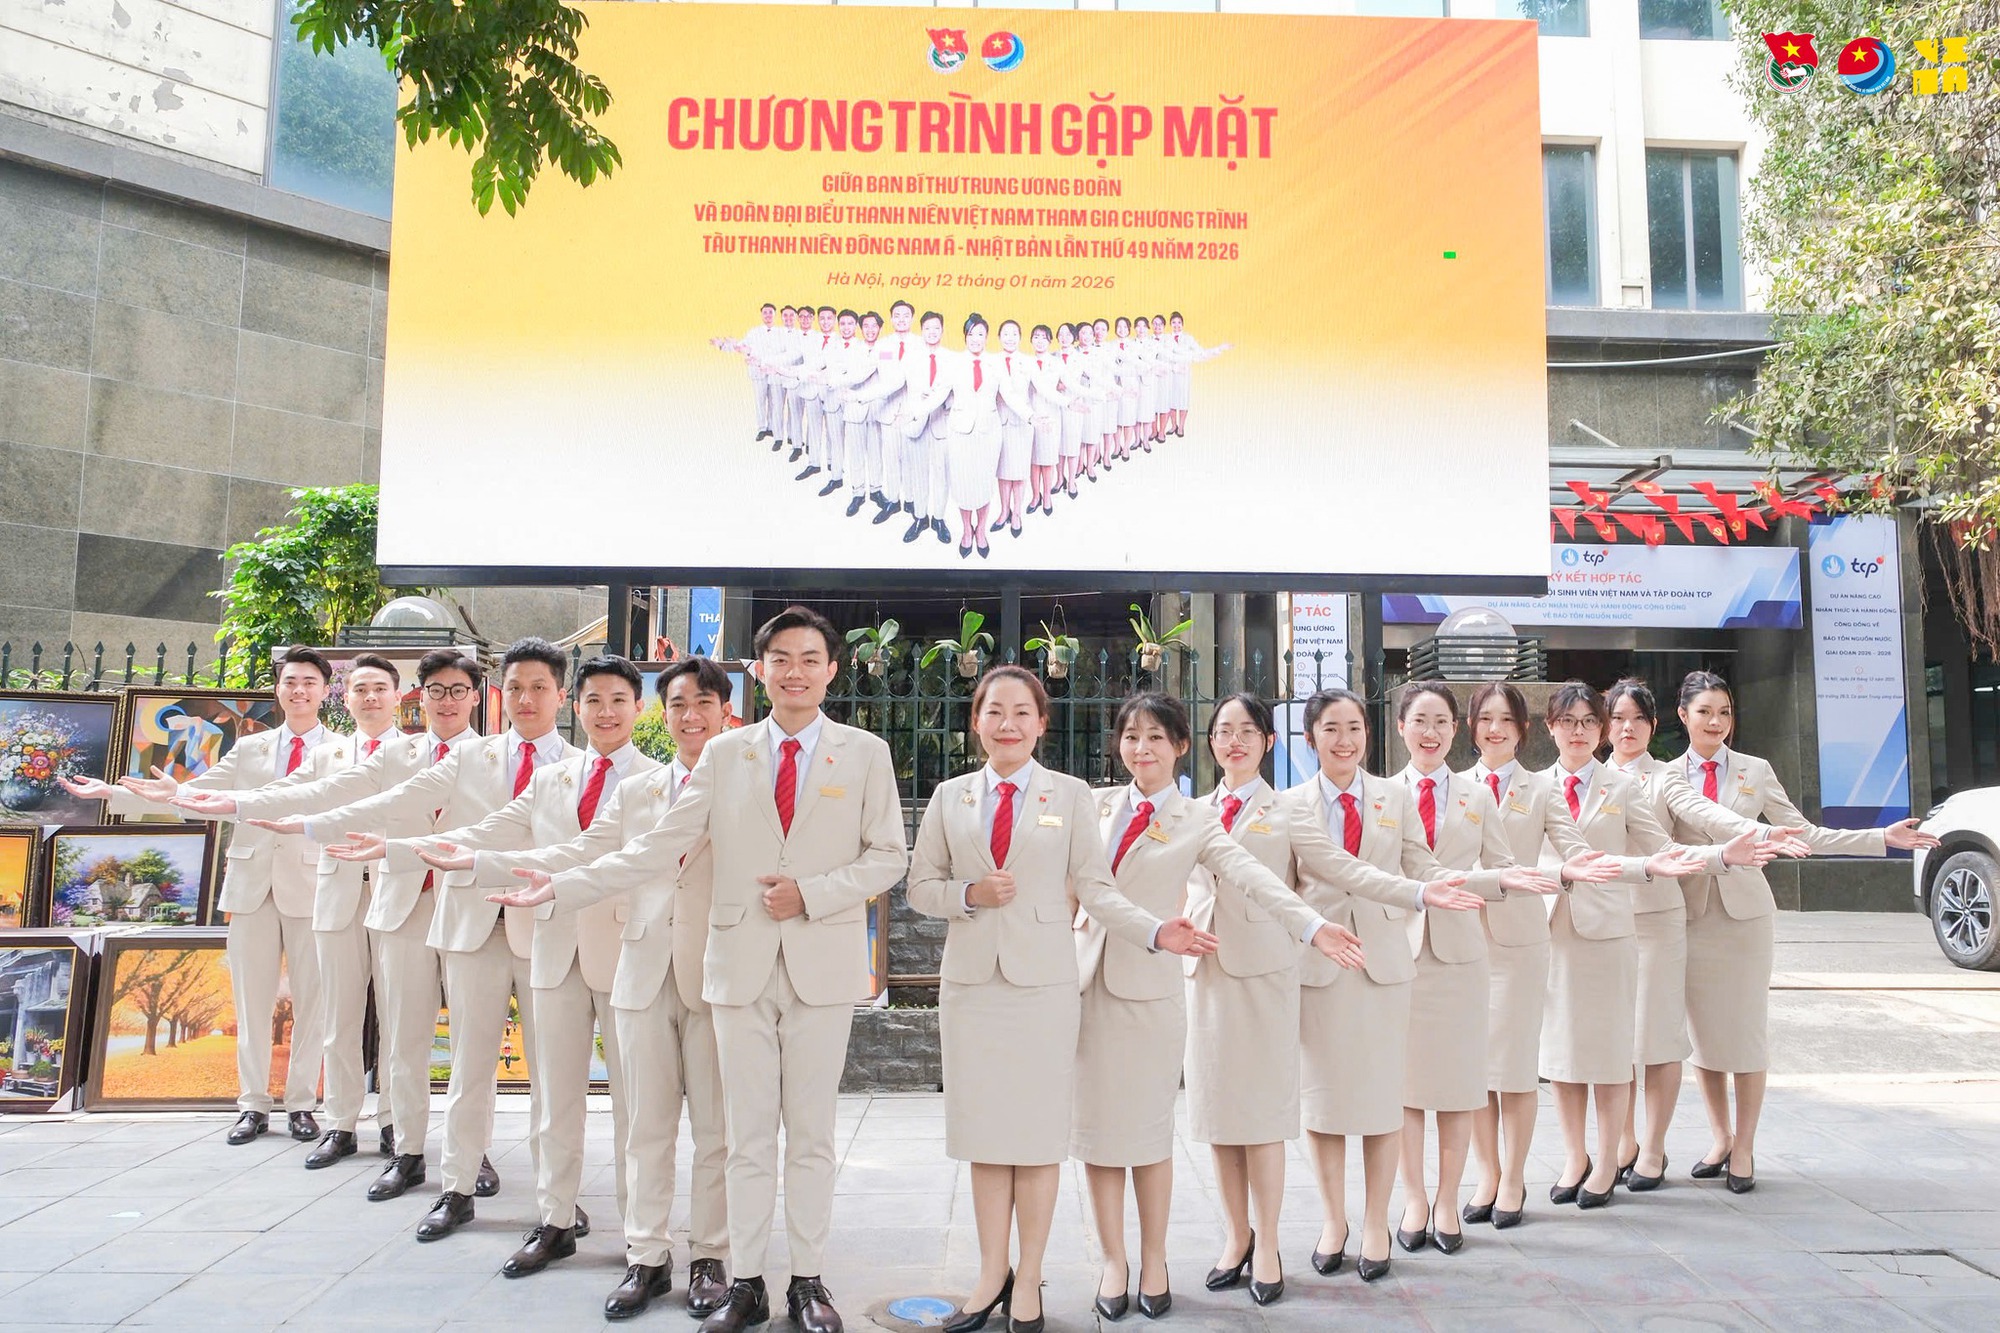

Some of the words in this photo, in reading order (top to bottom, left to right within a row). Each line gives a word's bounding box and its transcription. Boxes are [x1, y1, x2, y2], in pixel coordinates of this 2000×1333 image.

[667, 94, 884, 153] CHƯƠNG
[887, 91, 1042, 155] TRÌNH
[1051, 91, 1153, 170] GẶP
[1163, 93, 1278, 171] MẶT
[822, 172, 863, 193] GIỮA
[866, 175, 903, 194] BAN
[906, 173, 924, 194] BÍ
[925, 175, 960, 194] THƯ
[961, 177, 1019, 195] TRUNG
[1021, 175, 1070, 196] ƯƠNG
[1073, 175, 1122, 197] ĐOÀN
[694, 200, 718, 222] VÀ
[720, 201, 770, 223] ĐOÀN
[772, 204, 802, 227] ĐẠI
[805, 198, 844, 224] BIỂU
[846, 206, 904, 224] THANH
[908, 203, 950, 225] NIÊN
[952, 204, 989, 229] VIỆT
[991, 207, 1034, 226] NAM
[1036, 208, 1087, 227] THAM
[1090, 210, 1119, 227] GIA
[1122, 209, 1194, 229] CHƯƠNG
[1195, 207, 1248, 230] TRÌNH
[702, 231, 736, 253] TÀU
[738, 235, 796, 254] THANH
[800, 232, 842, 254] NIÊN
[845, 233, 895, 255] ĐÔNG
[897, 237, 941, 256] NAM
[943, 234, 955, 256] Á
[966, 235, 1014, 260] NHẬT
[1015, 234, 1053, 257] BẢN
[1055, 234, 1088, 258] LẦN
[1090, 237, 1125, 259] THỨ
[1126, 241, 1149, 259] 49
[1151, 237, 1194, 260] NĂM
[1197, 242, 1239, 260] 2026
[826, 271, 850, 285] Hà
[853, 272, 885, 289] Nội,
[889, 273, 932, 289] ngày
[936, 273, 953, 287] 12
[957, 274, 1005, 290] tháng
[1009, 275, 1028, 288] 01
[1030, 276, 1067, 288] năm
[1071, 276, 1115, 289] 2026
[1583, 549, 1606, 567] tcp
[1850, 557, 1880, 579] tcp
[1566, 570, 1588, 583] KẾT
[1591, 572, 1616, 585] HỢP
[1619, 571, 1642, 584] TÁC
[1557, 589, 1578, 597] SINH
[1579, 588, 1598, 597] VIÊN
[1600, 589, 1618, 599] VIỆT
[1619, 590, 1639, 598] NAM
[1640, 589, 1652, 598] VÀ
[1653, 590, 1669, 599] TẬP
[1670, 589, 1694, 598] ĐOÀN
[1697, 591, 1712, 599] TCP
[698, 613, 720, 623] THA
[1305, 604, 1331, 617] TÁC
[1313, 624, 1335, 632] ƯƠNG
[1309, 637, 1325, 646] VIỆT
